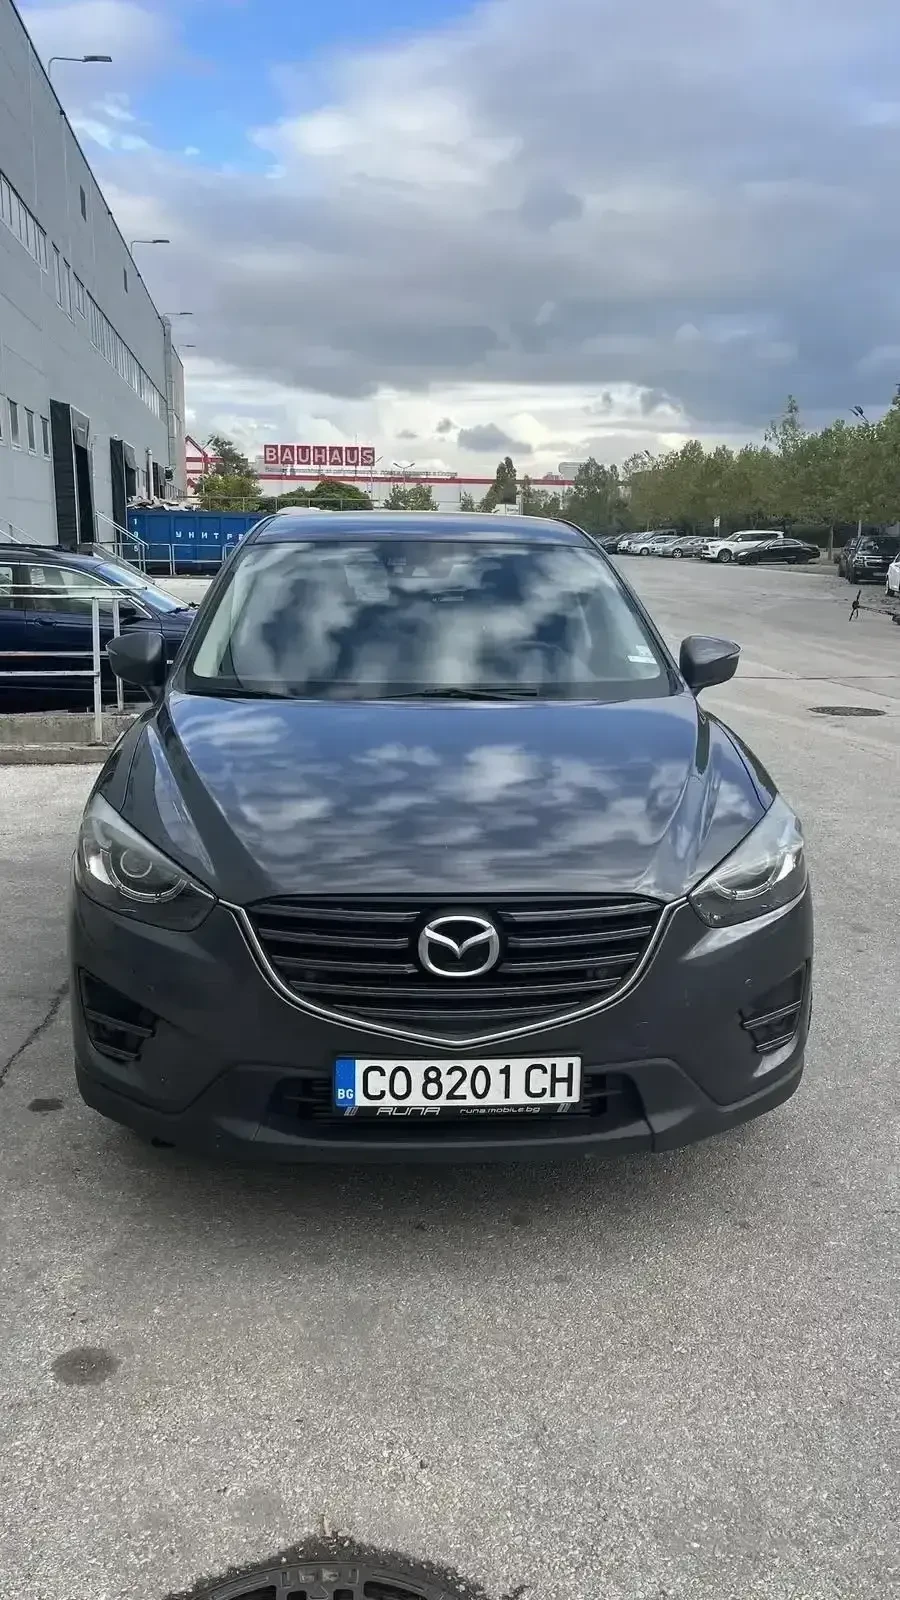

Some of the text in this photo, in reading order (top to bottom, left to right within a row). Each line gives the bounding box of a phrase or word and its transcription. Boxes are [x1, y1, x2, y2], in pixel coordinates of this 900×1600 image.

[264, 446, 374, 465] BAUHAUS
[362, 1063, 574, 1100] CO 8201 CH
[337, 1089, 354, 1100] BG
[376, 1106, 541, 1116] RUNA runa.mobile.bg
